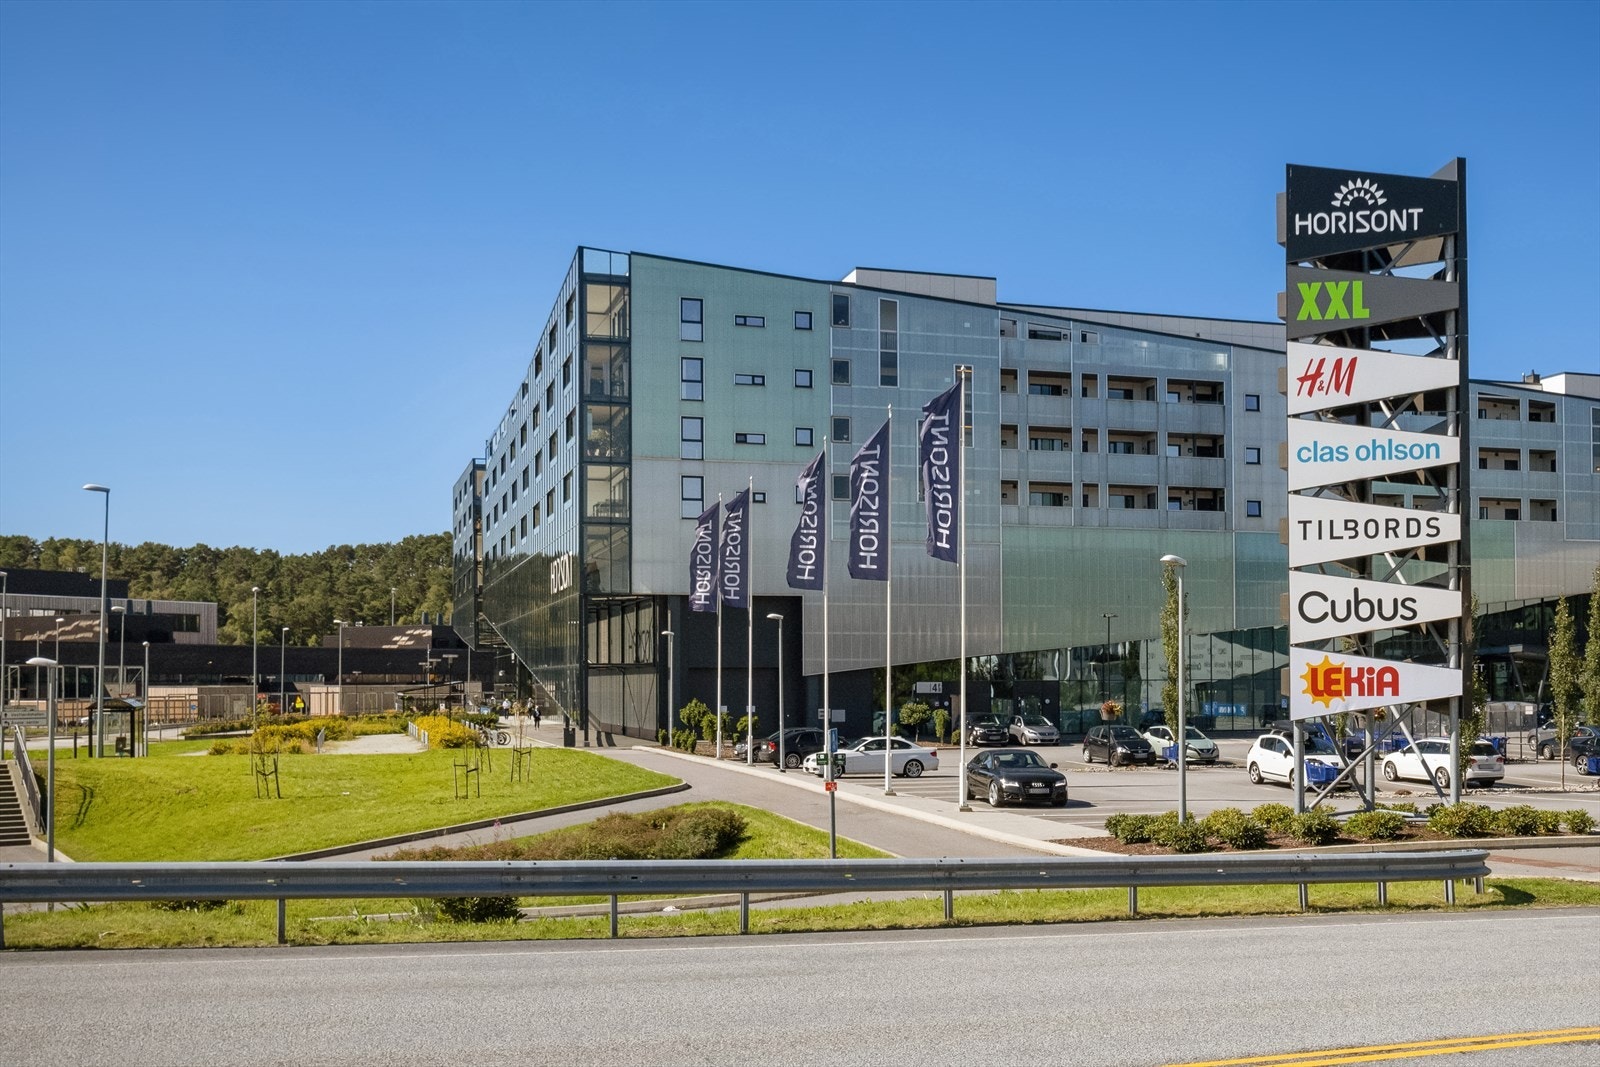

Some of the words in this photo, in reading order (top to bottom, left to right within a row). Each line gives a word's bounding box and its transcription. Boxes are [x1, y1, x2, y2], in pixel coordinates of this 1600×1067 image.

[1295, 208, 1423, 235] HORISONT
[1296, 280, 1370, 320] XXL
[1296, 356, 1358, 398] H&M
[1296, 440, 1349, 463] clas
[1355, 438, 1440, 461] ohlson
[1297, 516, 1441, 541] TILBORDS
[1297, 587, 1418, 624] Cubus
